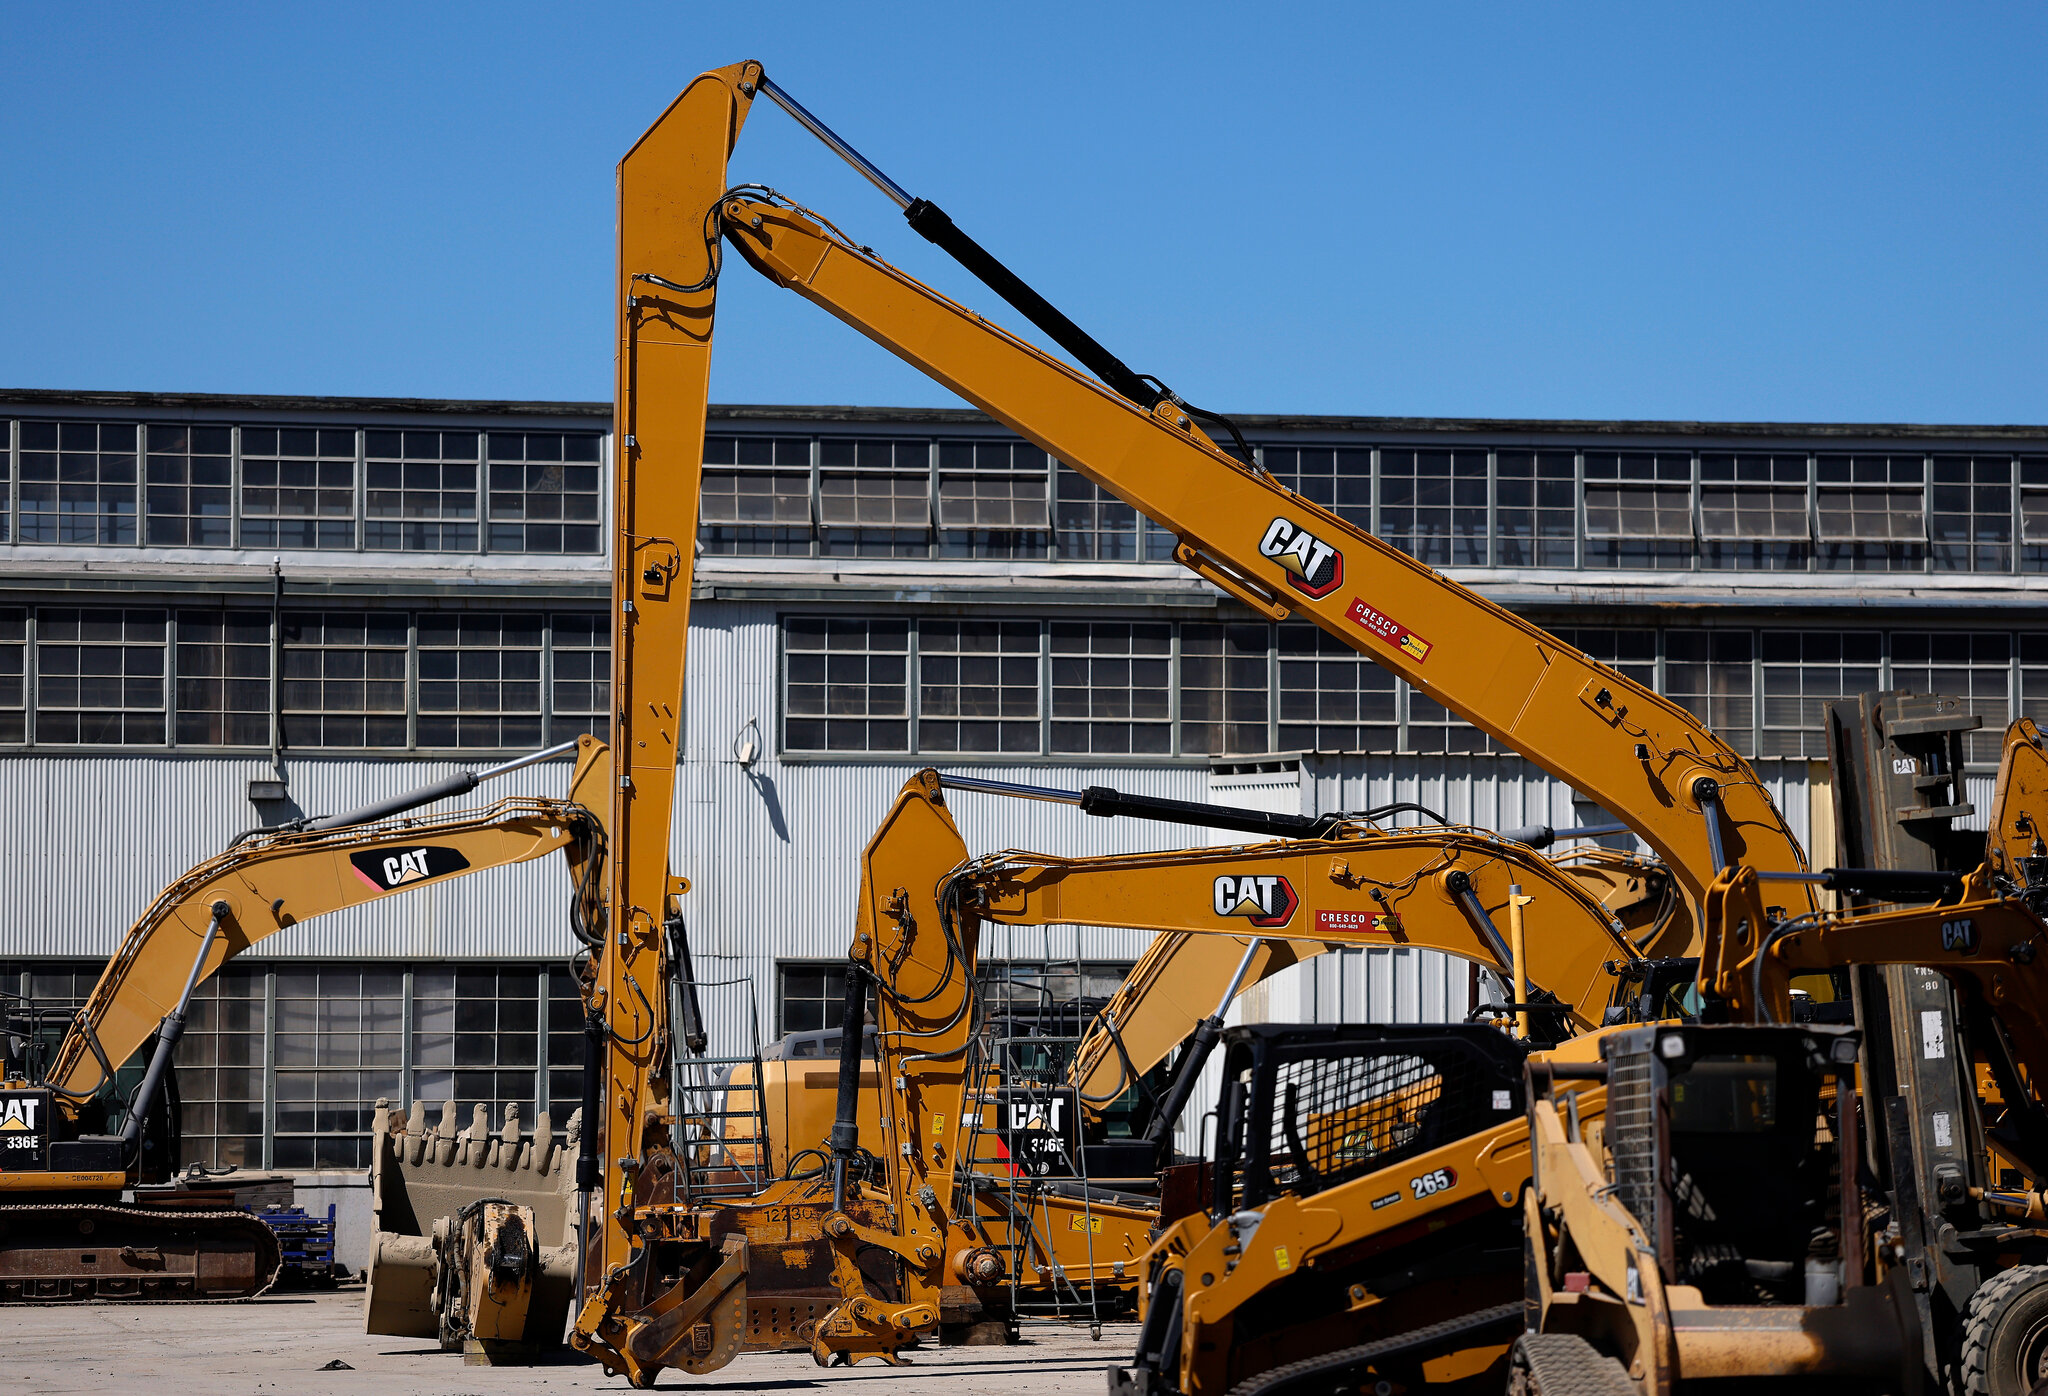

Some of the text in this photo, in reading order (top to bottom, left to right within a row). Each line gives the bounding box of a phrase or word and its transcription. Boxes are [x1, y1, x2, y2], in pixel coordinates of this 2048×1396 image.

[1260, 518, 1335, 581] CAT
[1356, 603, 1398, 634] CRESCO
[1893, 758, 1917, 775] CAT
[383, 848, 429, 885] CAT
[1215, 876, 1277, 915] CAT
[1321, 913, 1365, 923] CRESCO
[1941, 919, 1971, 951] CAT
[0, 1099, 39, 1130] AT
[7, 1135, 39, 1149] 336E
[1411, 1169, 1449, 1199] 265
